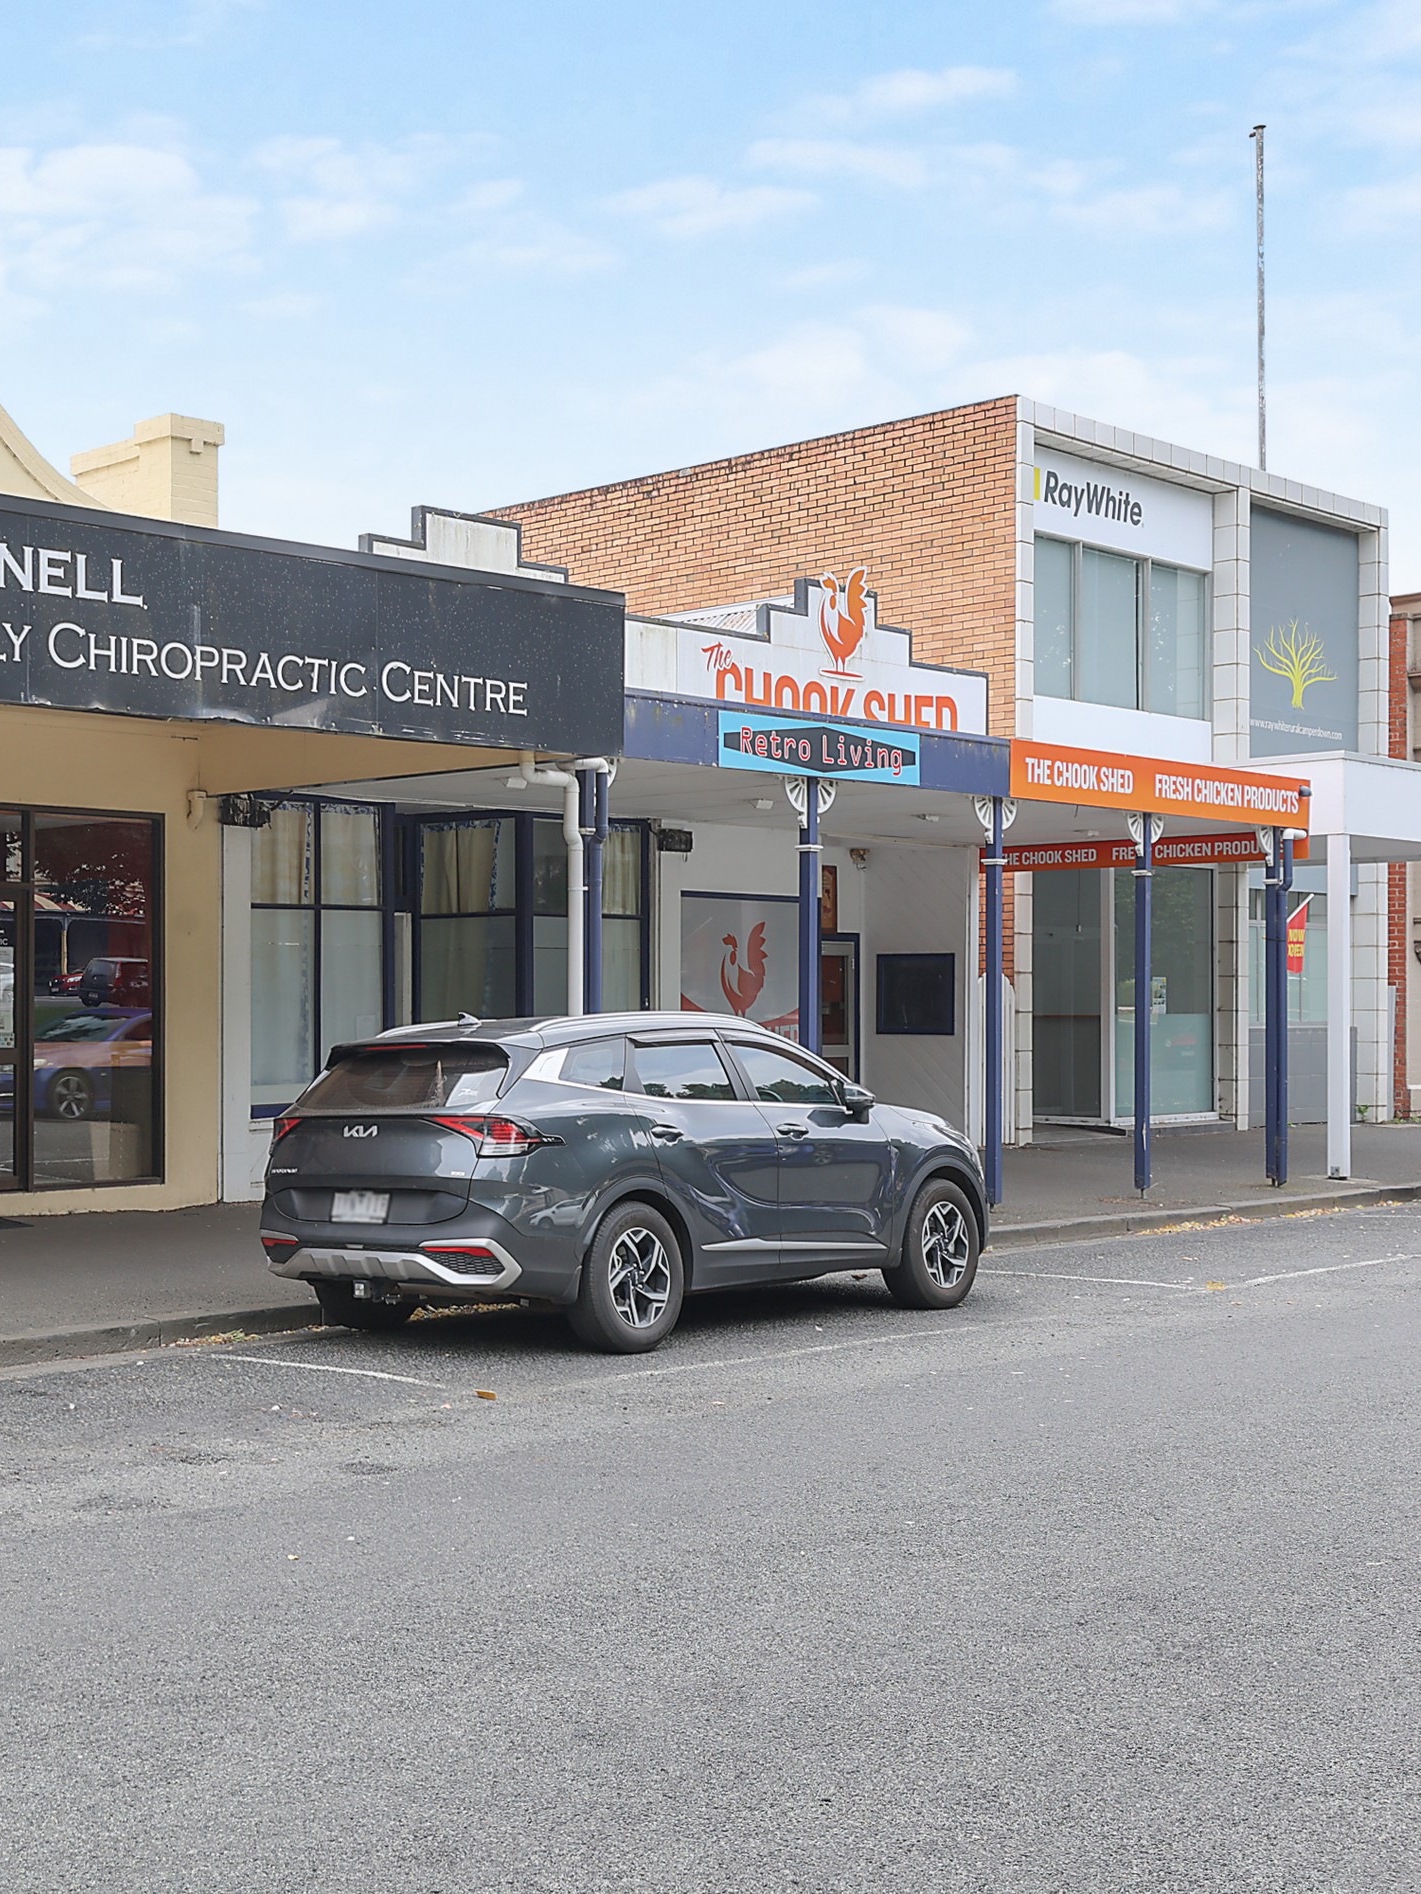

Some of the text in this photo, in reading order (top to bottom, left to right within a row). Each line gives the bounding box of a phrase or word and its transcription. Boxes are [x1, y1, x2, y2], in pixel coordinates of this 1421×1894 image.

[1043, 470, 1142, 526] RayWhite
[48, 622, 368, 697] CHIROPRACTIC
[381, 661, 528, 716] CENTRE
[701, 642, 732, 672] The
[740, 726, 903, 776] Retro Living
[1025, 757, 1299, 814] THE CHOOK SHED FRESH CHICKEN PRODUCTS
[1022, 850, 1063, 865] CHOOK
[1064, 848, 1097, 863] SHED
[1112, 846, 1136, 861] FRE
[1154, 842, 1212, 859] CHICKEN
[1214, 840, 1283, 856] PRODU
[343, 1125, 379, 1138] KIA
